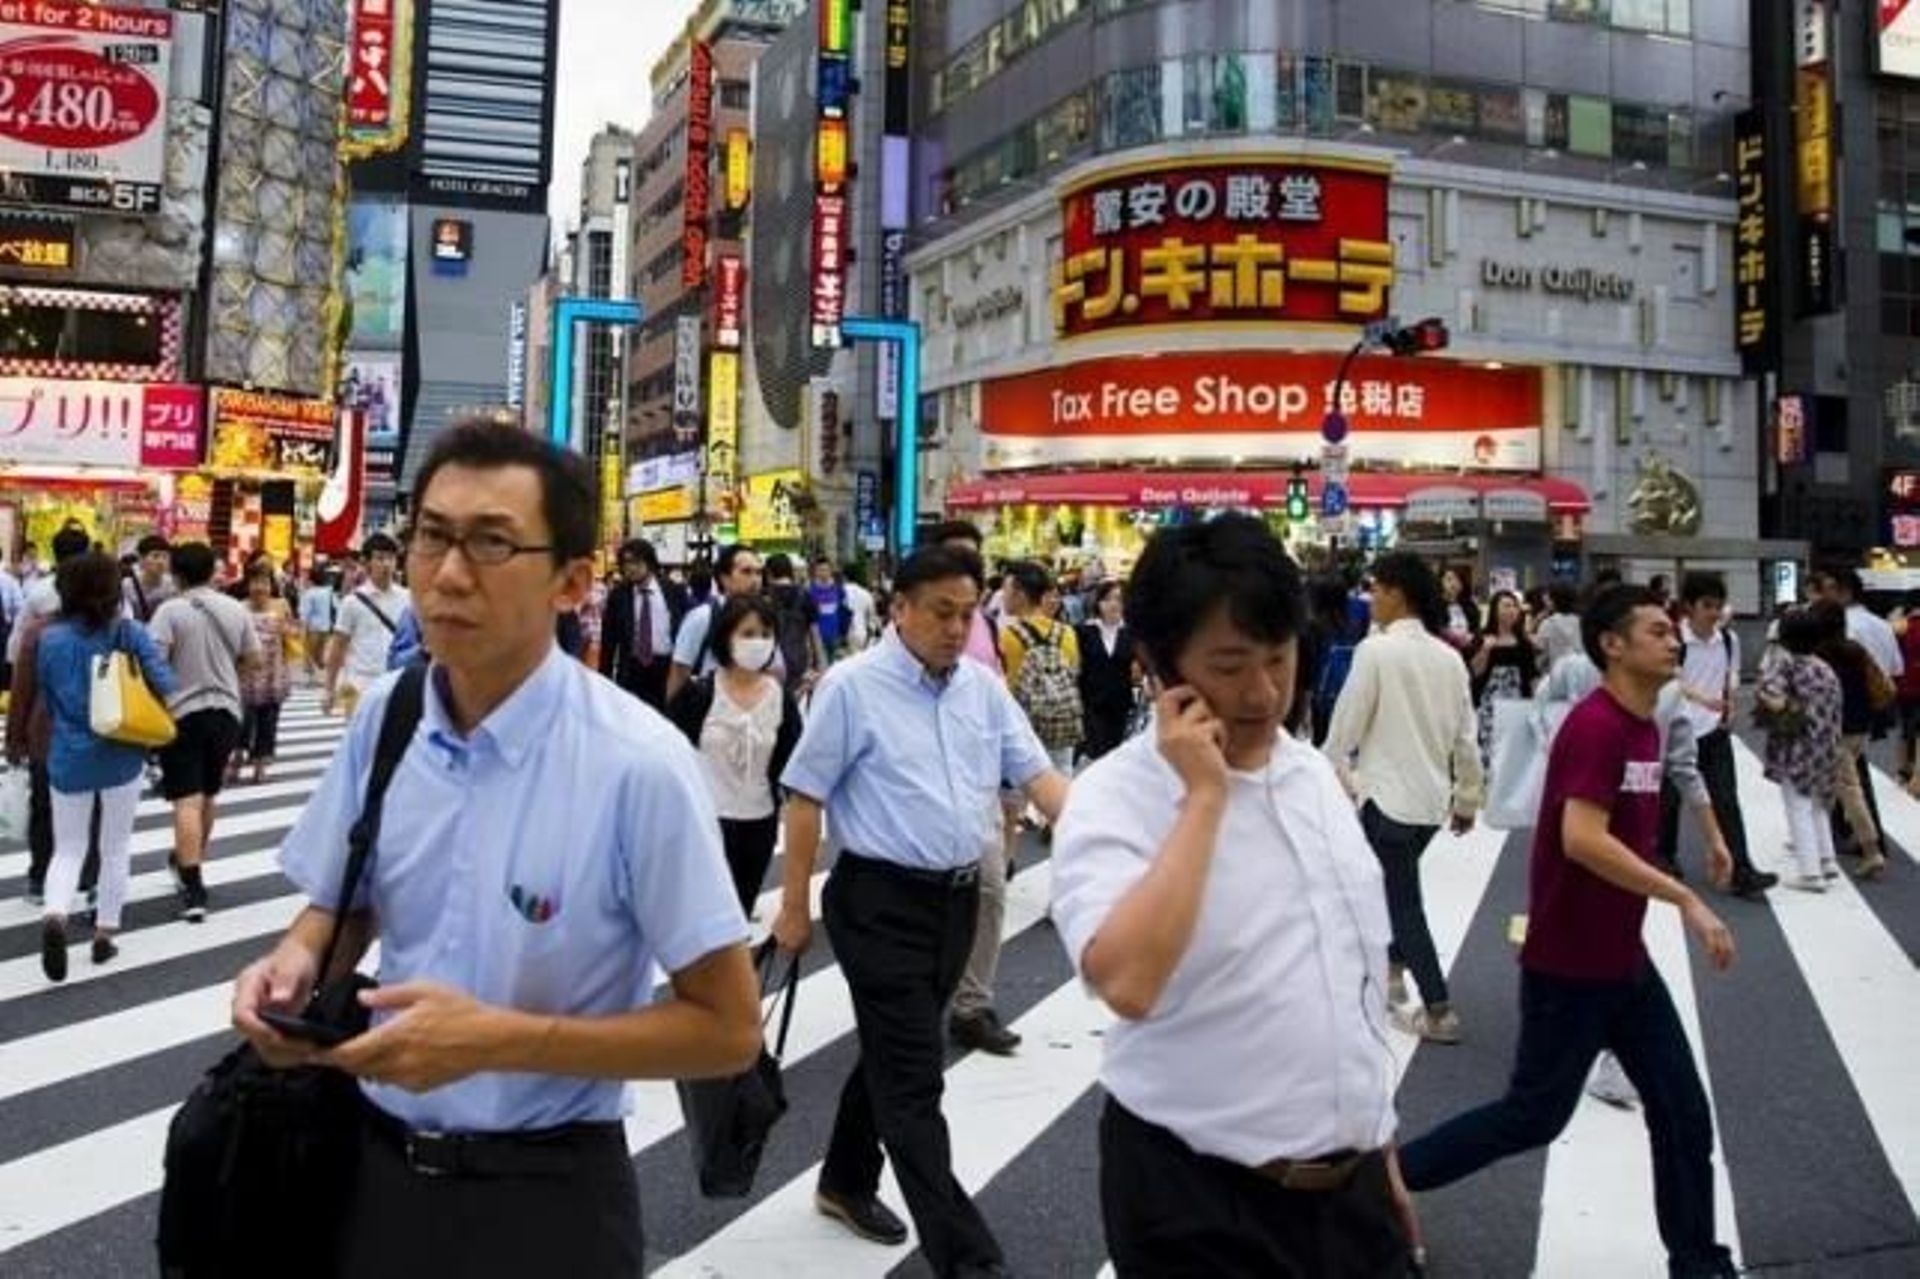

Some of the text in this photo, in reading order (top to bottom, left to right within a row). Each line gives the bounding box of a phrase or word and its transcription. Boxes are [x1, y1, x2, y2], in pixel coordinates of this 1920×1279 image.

[35, 7, 71, 25] for
[76, 7, 93, 27] 2
[100, 12, 168, 35] hours
[113, 183, 157, 209] 5F
[1092, 174, 1322, 235] 驚安の殿堂
[1482, 258, 1532, 289] Don
[1051, 389, 1094, 423] Tax
[1101, 382, 1181, 417] Free
[1193, 376, 1308, 422] Shop
[1140, 488, 1177, 502] Don
